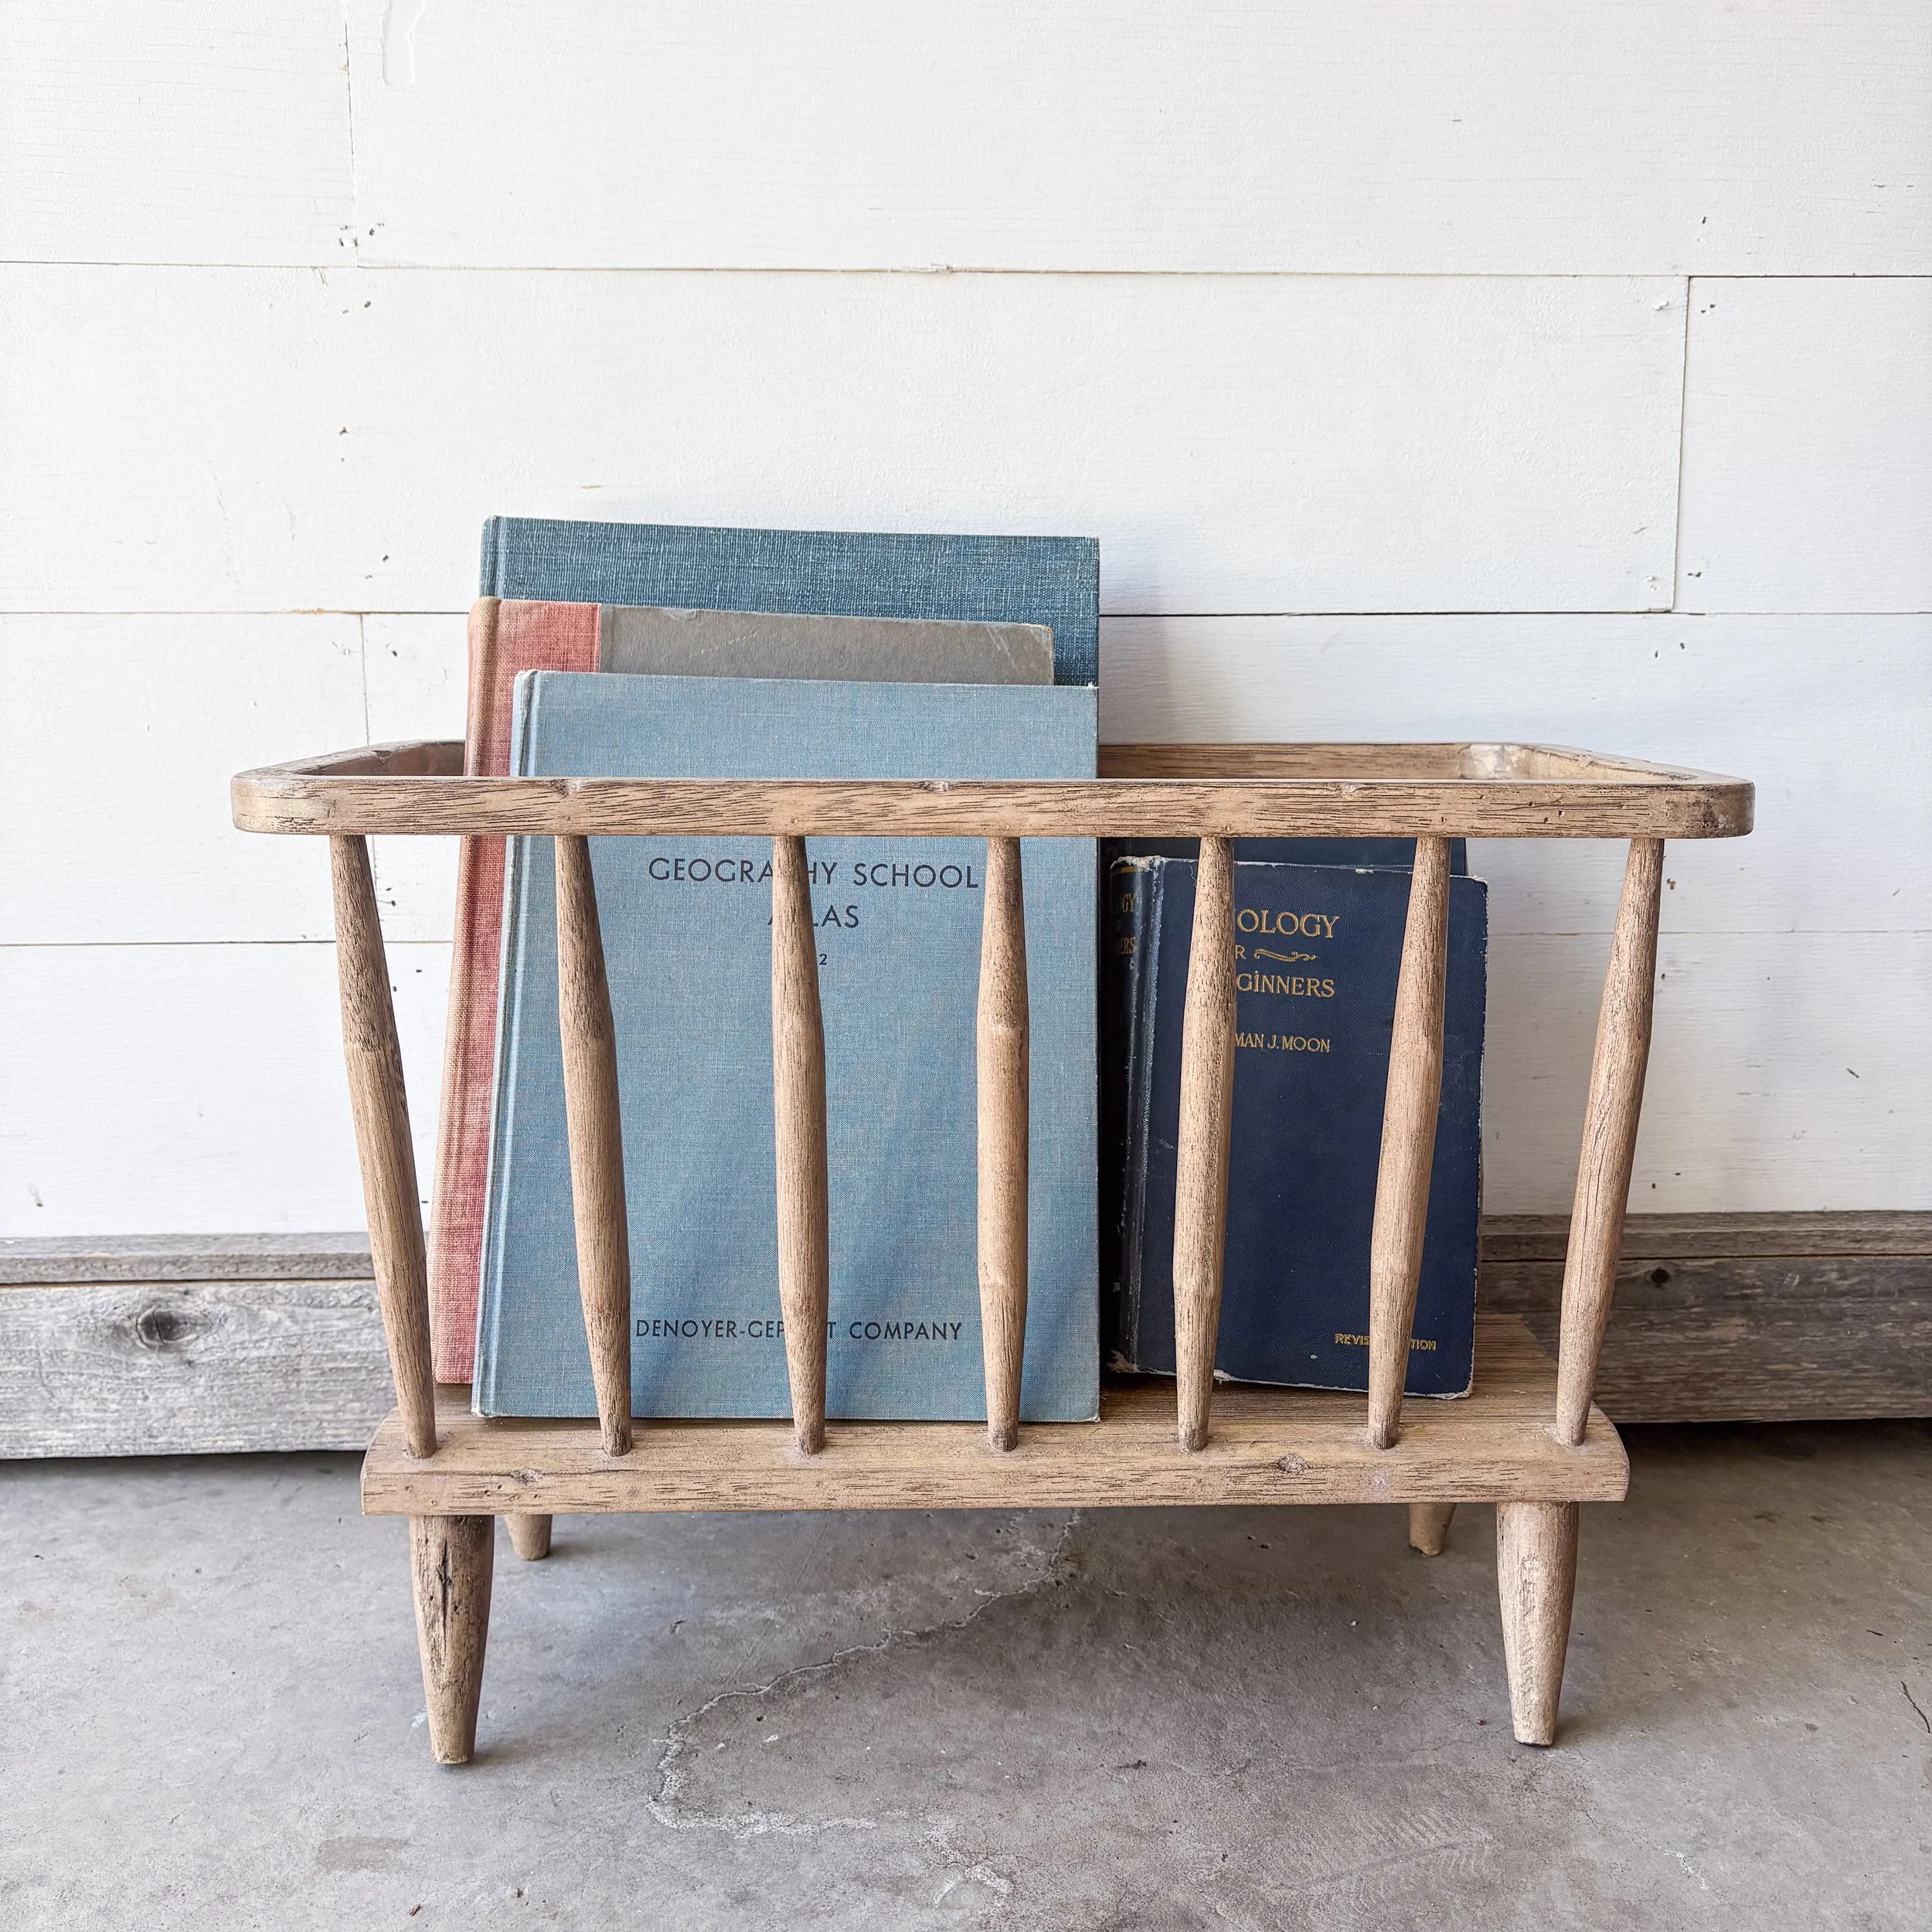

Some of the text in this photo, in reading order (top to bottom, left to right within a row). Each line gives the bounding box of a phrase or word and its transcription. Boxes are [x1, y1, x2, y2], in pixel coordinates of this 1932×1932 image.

[648, 857, 978, 889] GEOGRAHY SCHOOL
[1236, 909, 1339, 938] OLOGY
[1236, 973, 1335, 998] GINNERS
[1281, 1036, 1330, 1053] MOON
[635, 1319, 962, 1341] DENOYER-GEPT COMPANY
